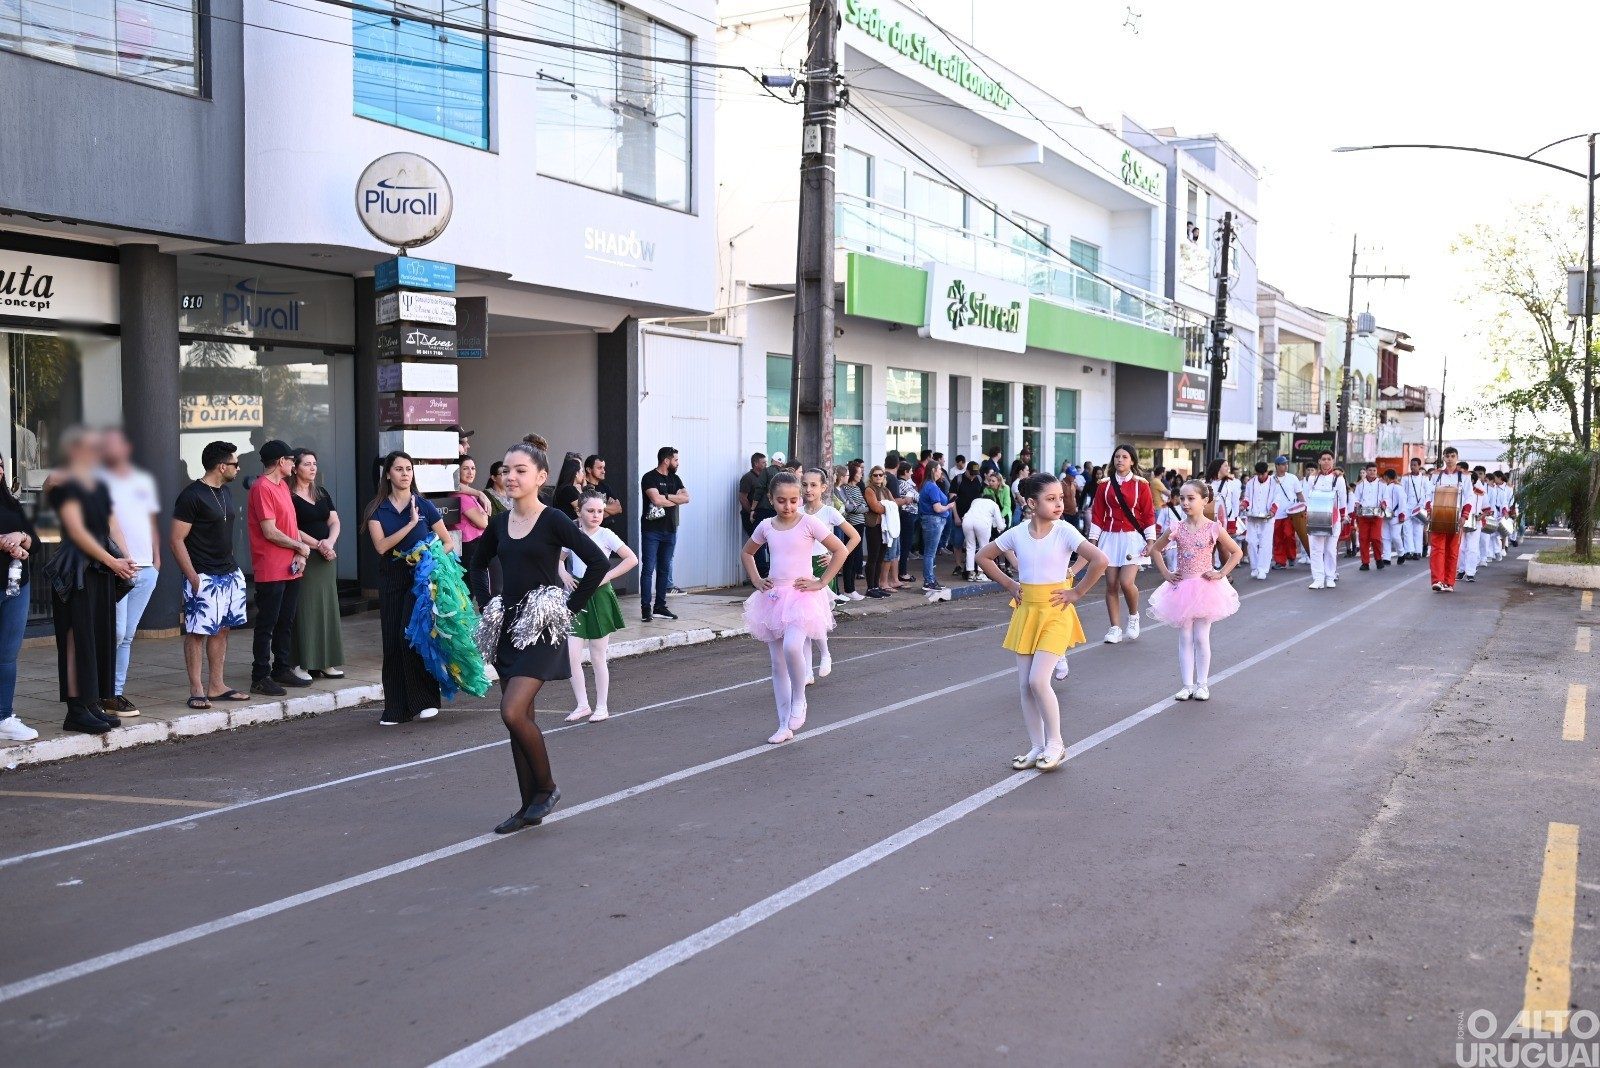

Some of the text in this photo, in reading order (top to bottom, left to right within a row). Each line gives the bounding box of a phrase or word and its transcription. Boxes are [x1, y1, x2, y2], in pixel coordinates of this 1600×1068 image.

[845, 0, 890, 42] Sede
[910, 33, 962, 84] Sicredi
[365, 189, 438, 216] Plurall
[584, 226, 657, 262] SHADOW
[0, 297, 51, 312] oncept
[182, 295, 203, 309] 610
[222, 292, 299, 331] Plurall
[967, 291, 1020, 334] Sicredi
